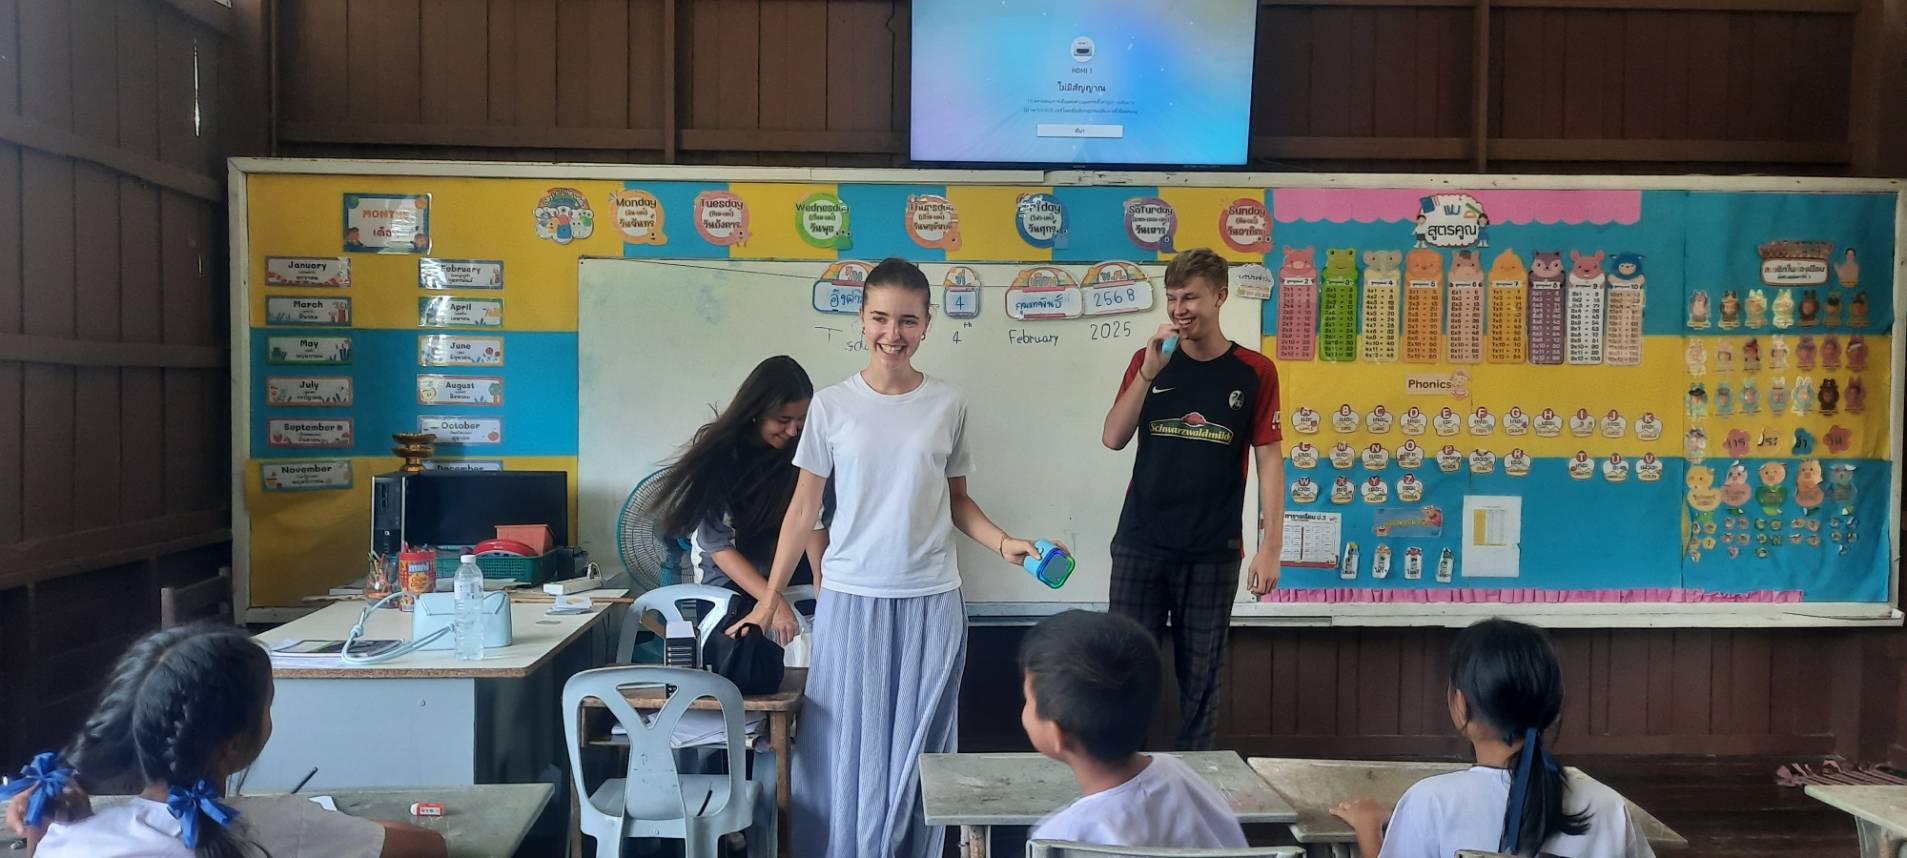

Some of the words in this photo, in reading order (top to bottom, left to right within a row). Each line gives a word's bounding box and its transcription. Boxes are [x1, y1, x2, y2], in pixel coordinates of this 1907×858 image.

[1057, 80, 1106, 94] ไม่มีสัญญาณ
[616, 198, 657, 209] Monday
[701, 199, 744, 210] Tuesday
[1128, 205, 1174, 216] Saturday
[1229, 206, 1266, 217] Sunday
[1427, 224, 1477, 240] สูตรคูณ
[288, 260, 327, 271] January
[441, 264, 481, 274] February
[830, 288, 863, 308] อังคา
[954, 295, 965, 310] 4
[1093, 288, 1135, 307] 2568
[293, 300, 324, 309] March
[450, 303, 472, 311] April
[1090, 321, 1131, 340] 2025
[1008, 329, 1059, 346] February
[300, 339, 319, 349] May
[450, 342, 472, 350] June
[299, 380, 319, 390] July
[445, 381, 475, 391] August
[1408, 379, 1452, 389] Phonics
[1342, 405, 1350, 415] B
[1375, 406, 1384, 416] C
[1410, 408, 1418, 417] D
[1442, 408, 1450, 418] E
[1478, 407, 1485, 418] F
[1511, 408, 1520, 417] G
[1544, 410, 1553, 419] H
[1580, 409, 1584, 419] I
[1609, 411, 1616, 420] J
[284, 423, 335, 432] September
[441, 421, 480, 430] October
[1371, 444, 1380, 453] N
[1406, 440, 1414, 450] O
[1513, 449, 1521, 458] R
[1612, 455, 1620, 464] U
[281, 464, 333, 474] November
[1370, 476, 1378, 486] Y
[1405, 476, 1413, 484] Z
